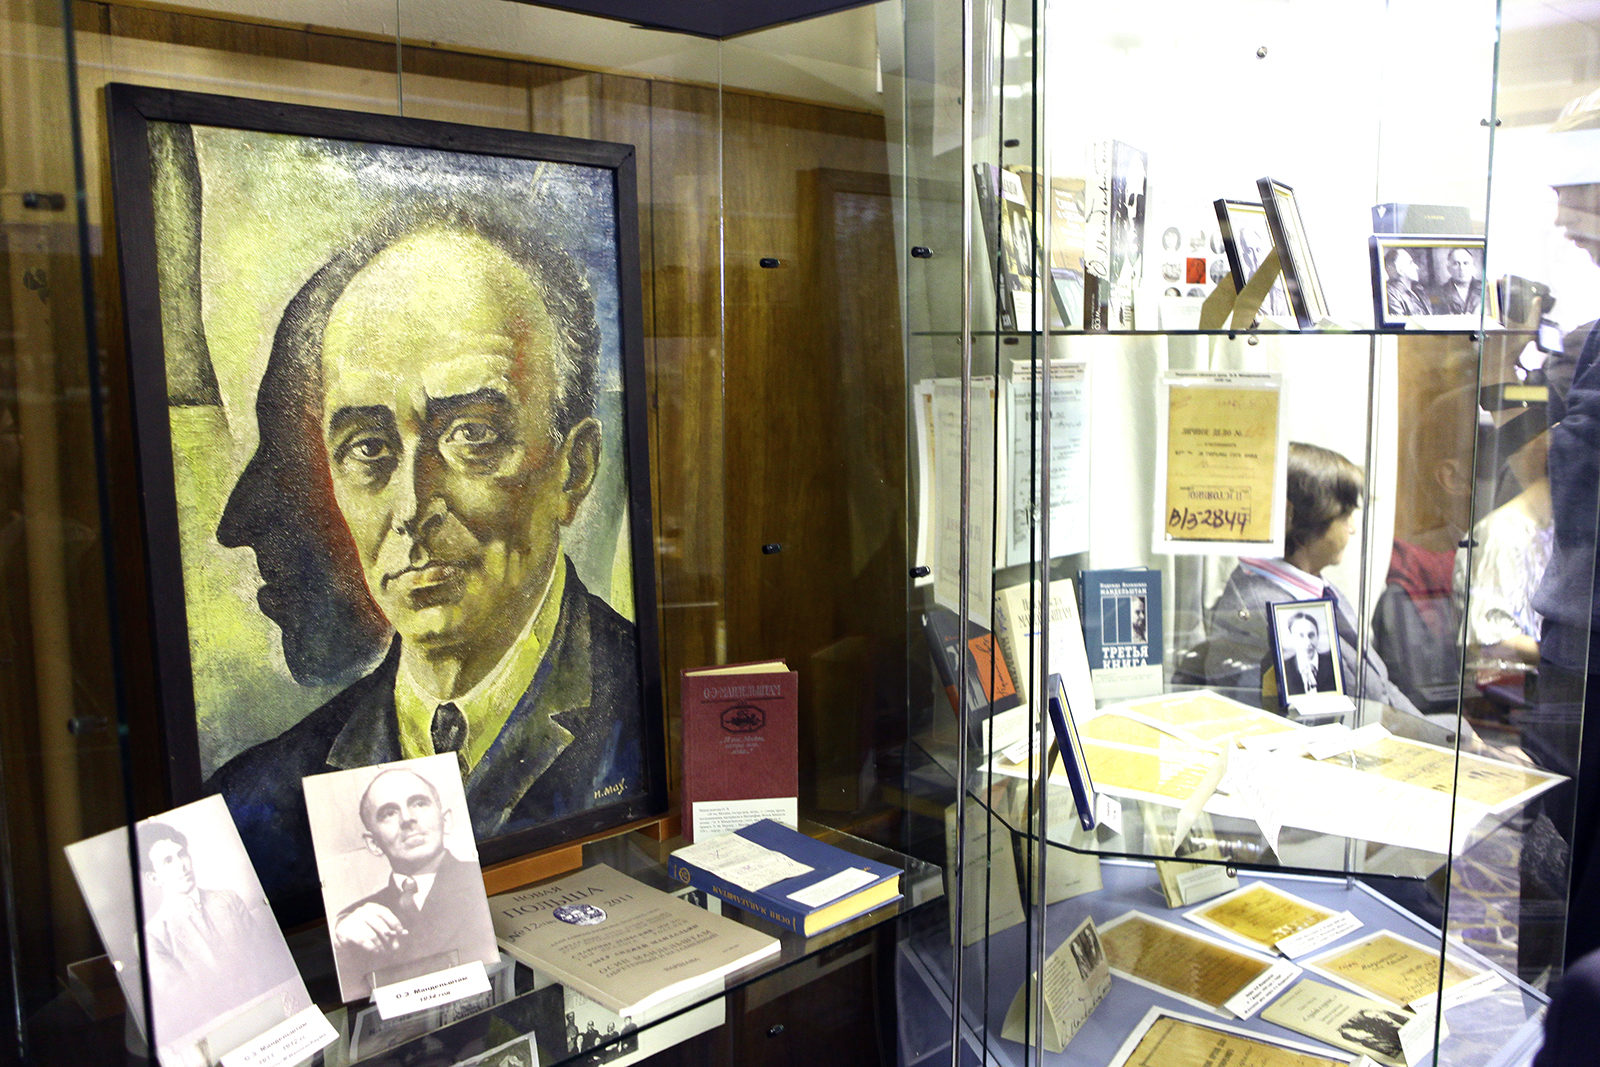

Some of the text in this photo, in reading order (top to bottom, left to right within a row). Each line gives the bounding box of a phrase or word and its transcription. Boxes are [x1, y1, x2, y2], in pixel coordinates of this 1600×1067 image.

[1102, 645, 1149, 659] ТРЕТЬЯ
[1102, 658, 1148, 669] КНИГА
[513, 886, 562, 902] НОВАЯ
[604, 894, 634, 907] 2011
[502, 887, 604, 919] ПОЛЬША
